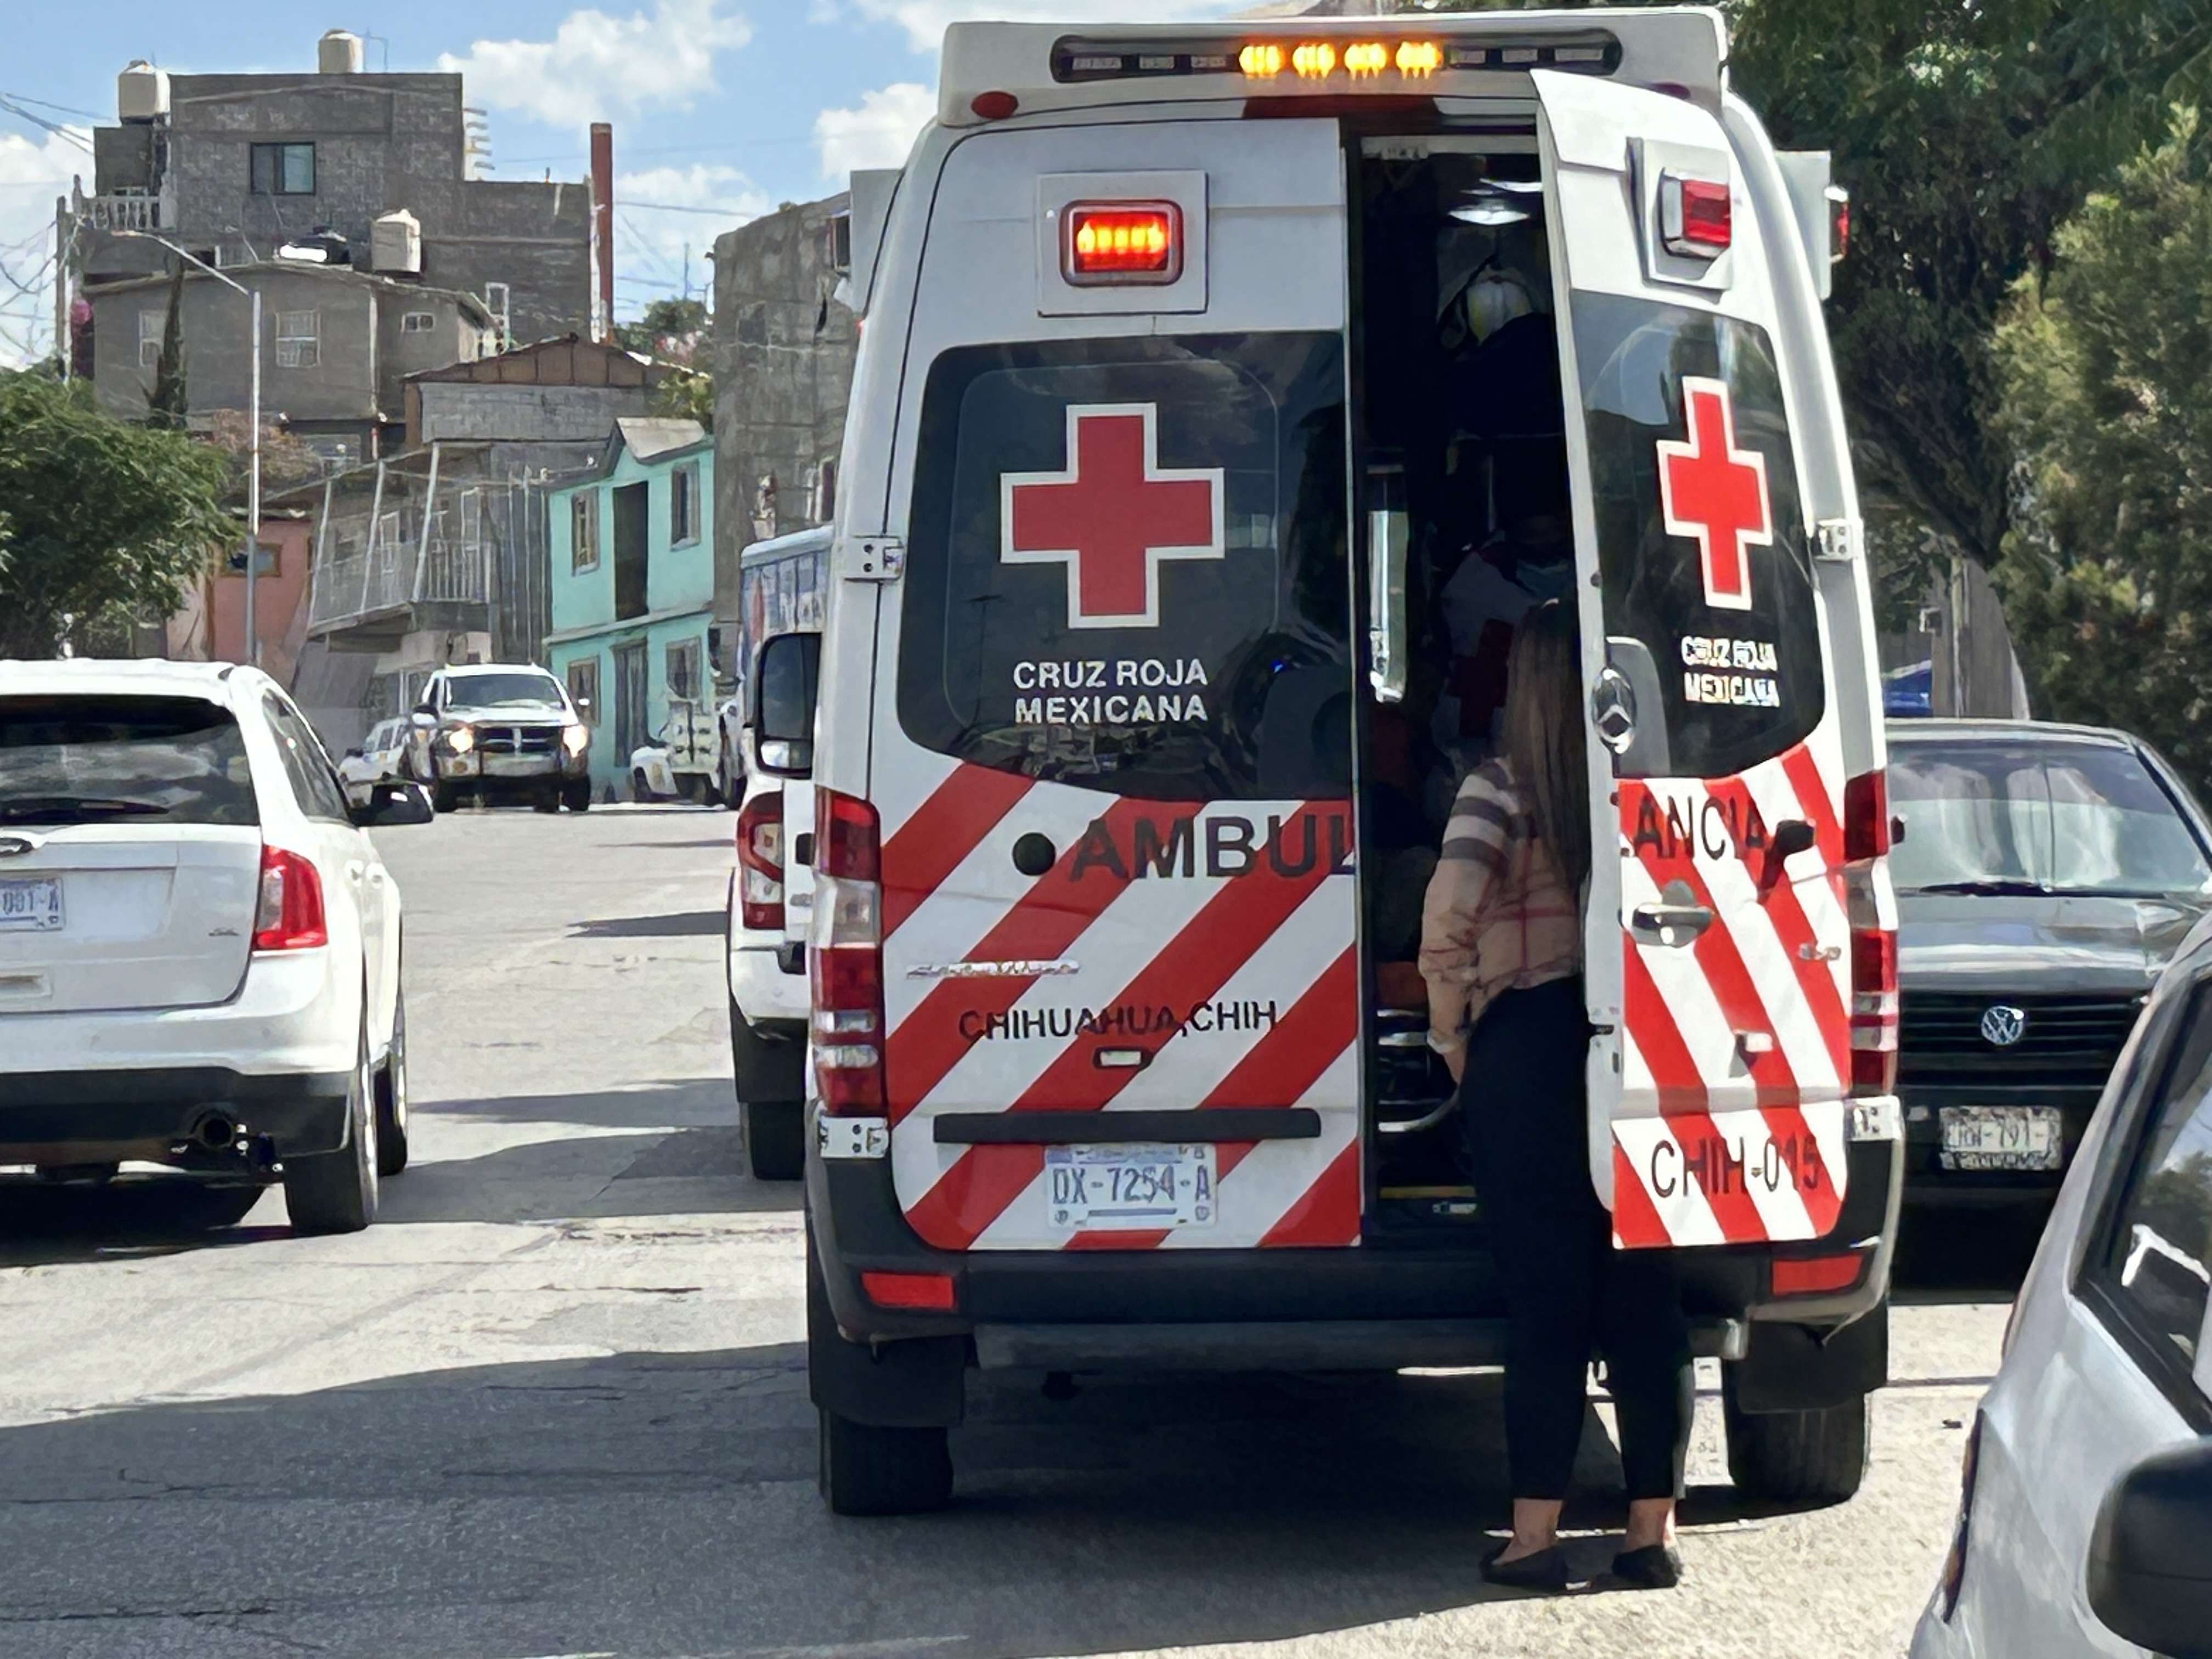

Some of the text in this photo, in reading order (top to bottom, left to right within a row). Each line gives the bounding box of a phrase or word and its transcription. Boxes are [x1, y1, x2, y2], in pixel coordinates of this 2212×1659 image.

[1013, 658, 1209, 690] CRUZ ROJA
[1014, 694, 1209, 724] MEXICANA
[1068, 815, 1356, 882] AMBUL
